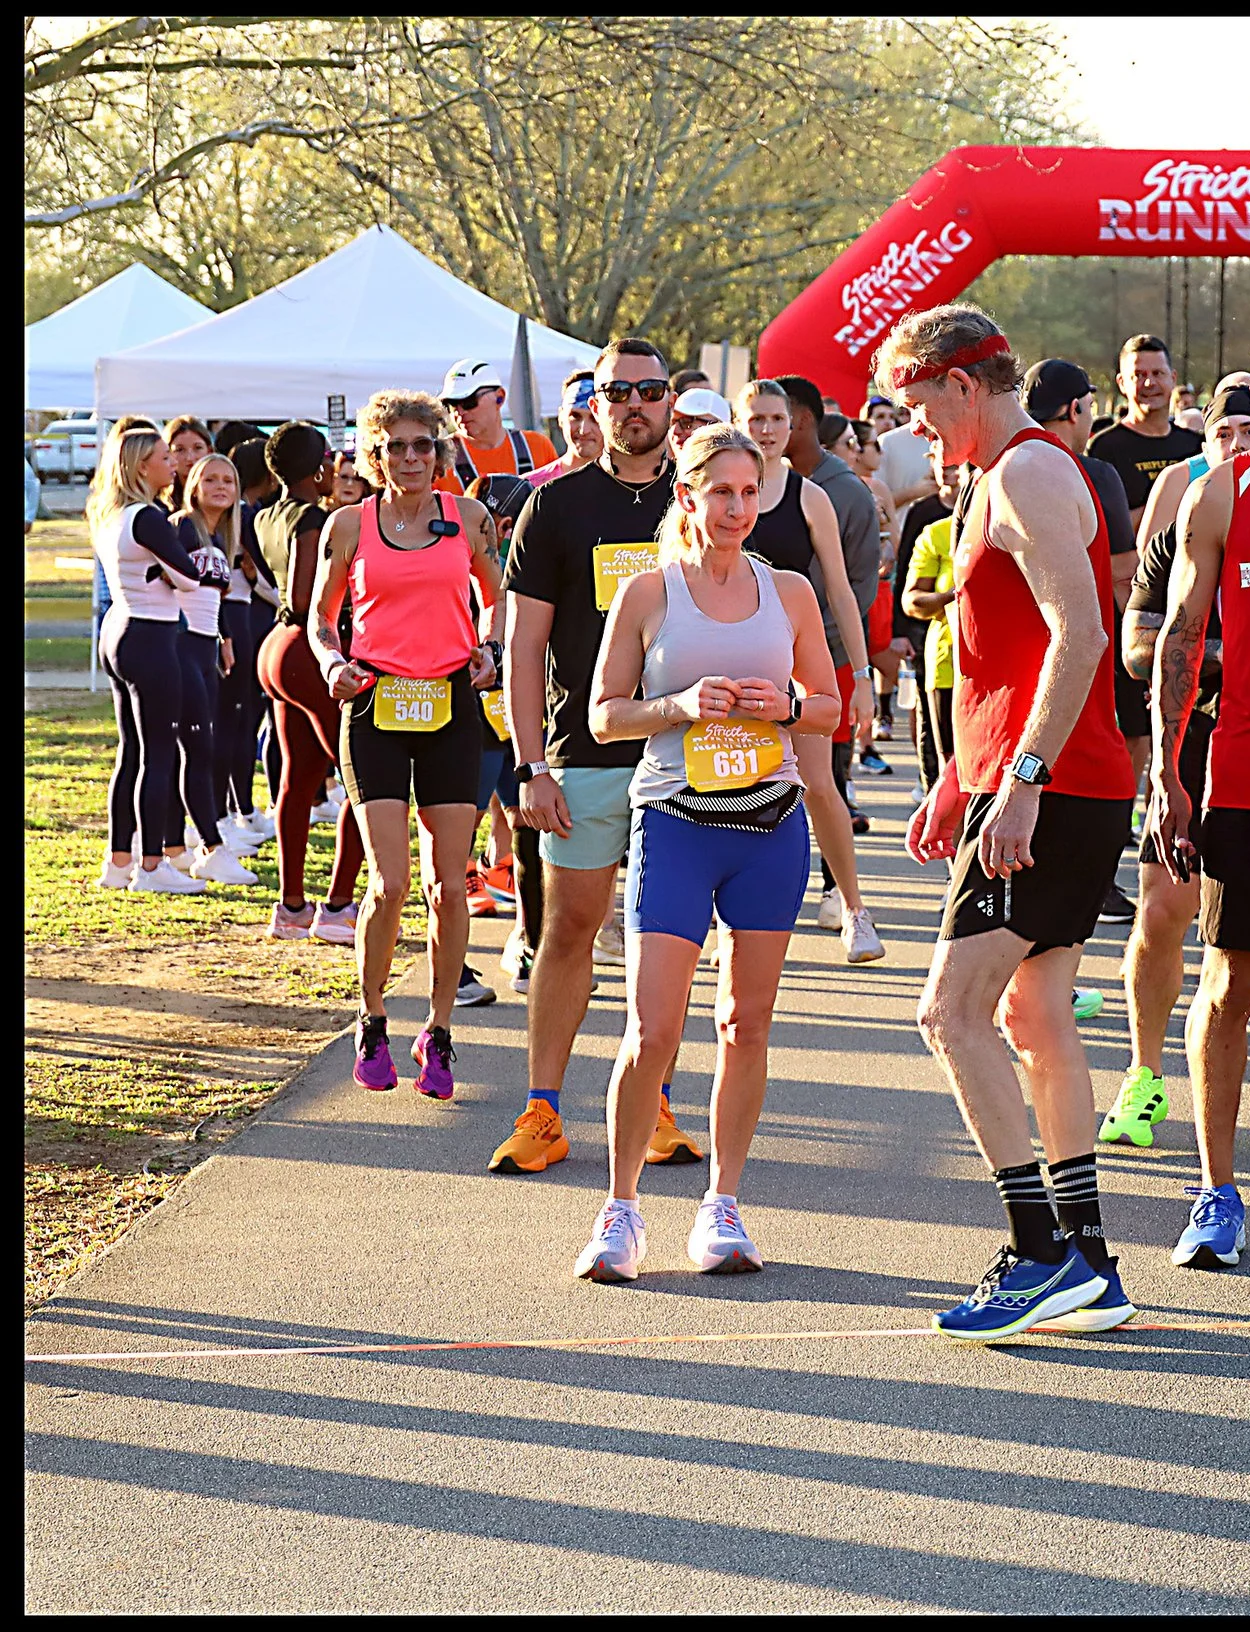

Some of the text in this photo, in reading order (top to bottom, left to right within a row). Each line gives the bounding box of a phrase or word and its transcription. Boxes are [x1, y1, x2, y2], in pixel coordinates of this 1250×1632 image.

[841, 229, 928, 326] Strictly
[833, 221, 974, 357] RUNNING
[382, 685, 447, 699] RUNNING
[395, 700, 434, 722] 540
[705, 722, 757, 741] Strictly
[692, 736, 774, 752] RUNNING
[713, 748, 758, 778] 631
